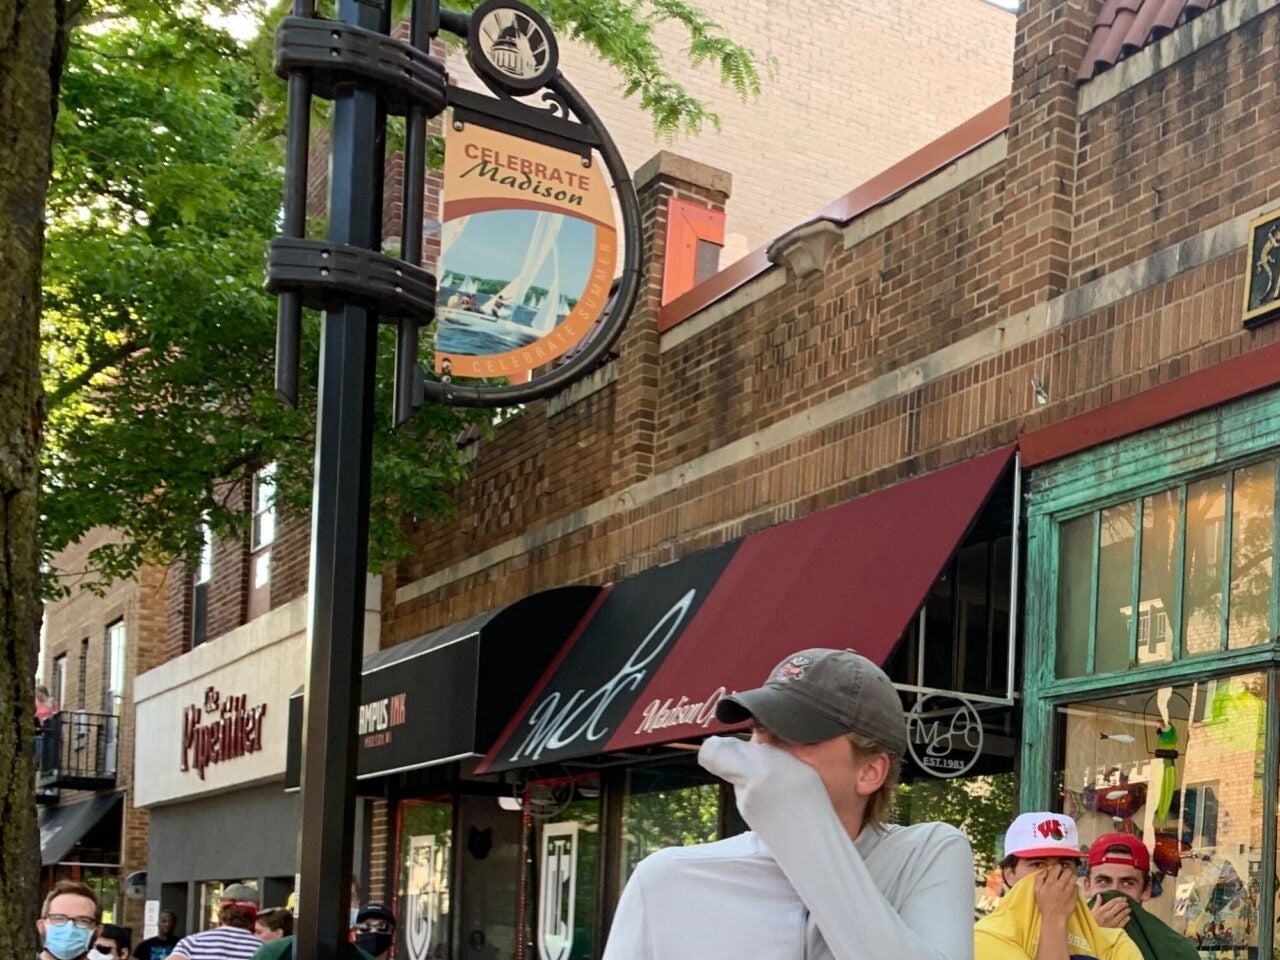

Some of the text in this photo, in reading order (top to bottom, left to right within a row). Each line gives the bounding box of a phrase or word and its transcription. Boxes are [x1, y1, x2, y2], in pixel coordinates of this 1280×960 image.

[459, 160, 583, 206] Madison
[464, 143, 590, 191] CELEBRATE
[471, 243, 612, 373] CELEBRATE SUMMER
[634, 695, 705, 735] Madison
